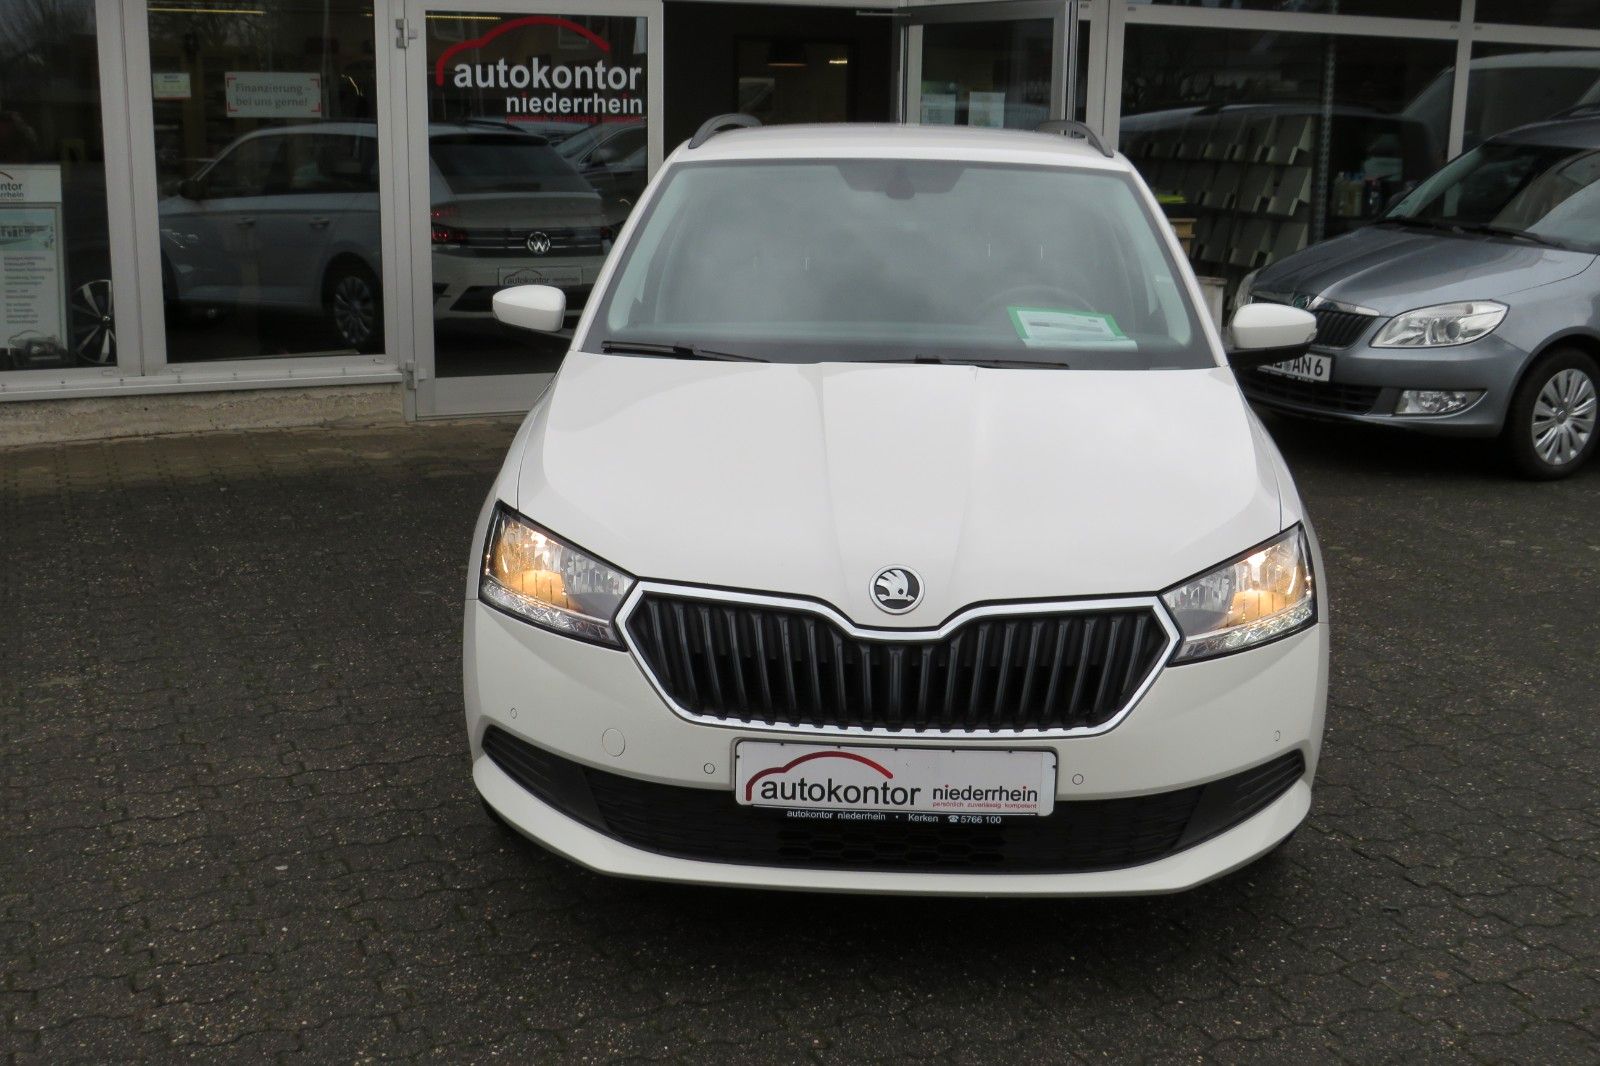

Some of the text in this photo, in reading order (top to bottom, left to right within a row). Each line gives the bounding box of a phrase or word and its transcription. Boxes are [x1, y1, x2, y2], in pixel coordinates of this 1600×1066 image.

[453, 57, 643, 89] autokontor
[235, 83, 303, 95] Finanzierung
[236, 95, 308, 108] bei uns gerne!
[505, 91, 643, 114] niederrhein
[1314, 358, 1324, 377] 6
[760, 777, 1038, 806] autokontor niederrhein
[786, 810, 1001, 824] autokontor niederrhein Kerken 5766 100
